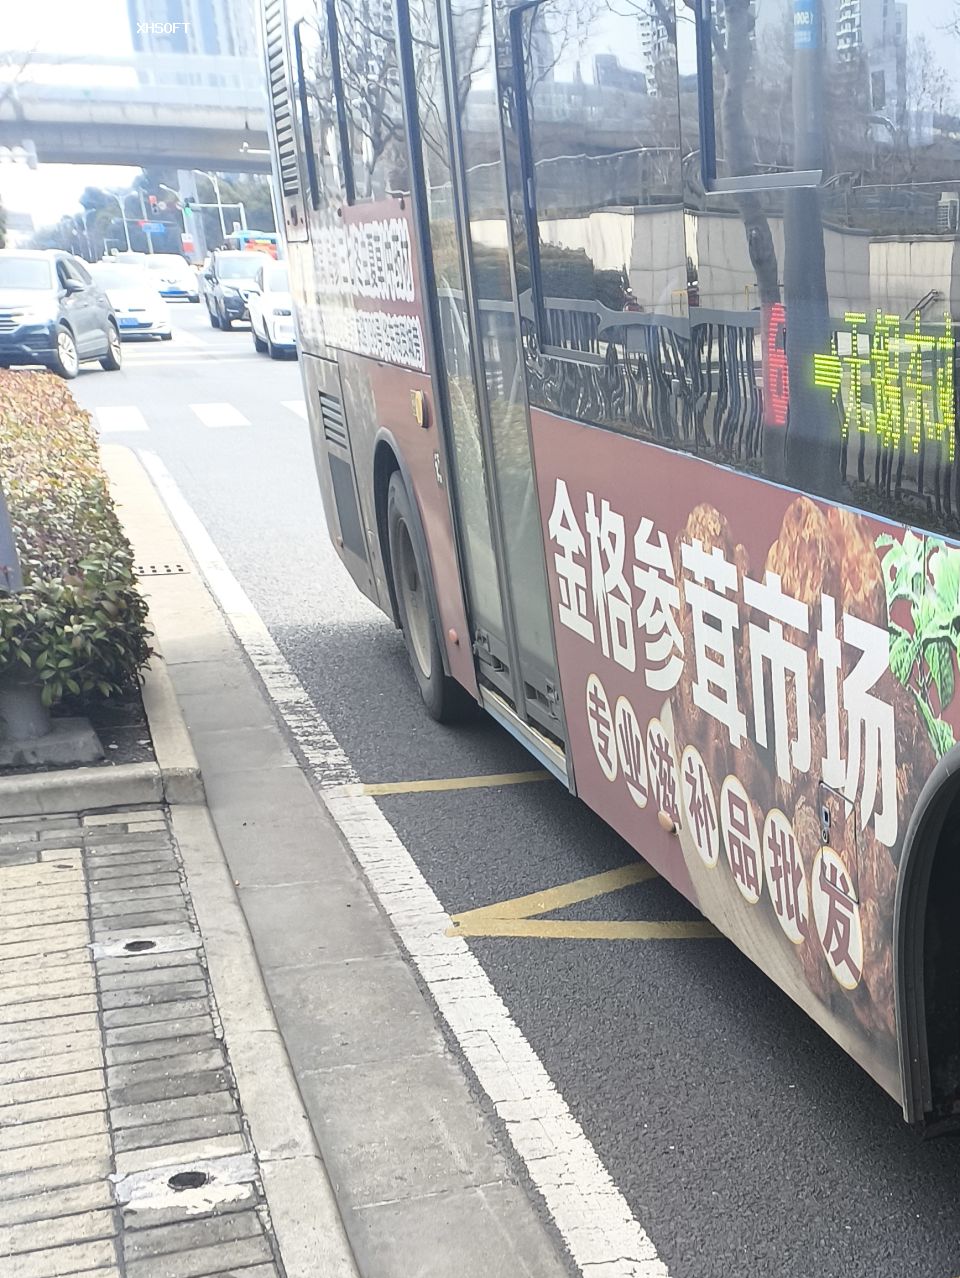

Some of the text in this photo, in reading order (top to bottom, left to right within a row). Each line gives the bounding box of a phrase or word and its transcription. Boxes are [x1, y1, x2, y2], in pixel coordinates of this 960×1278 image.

[588, 680, 863, 986] 专业滋补品批发
